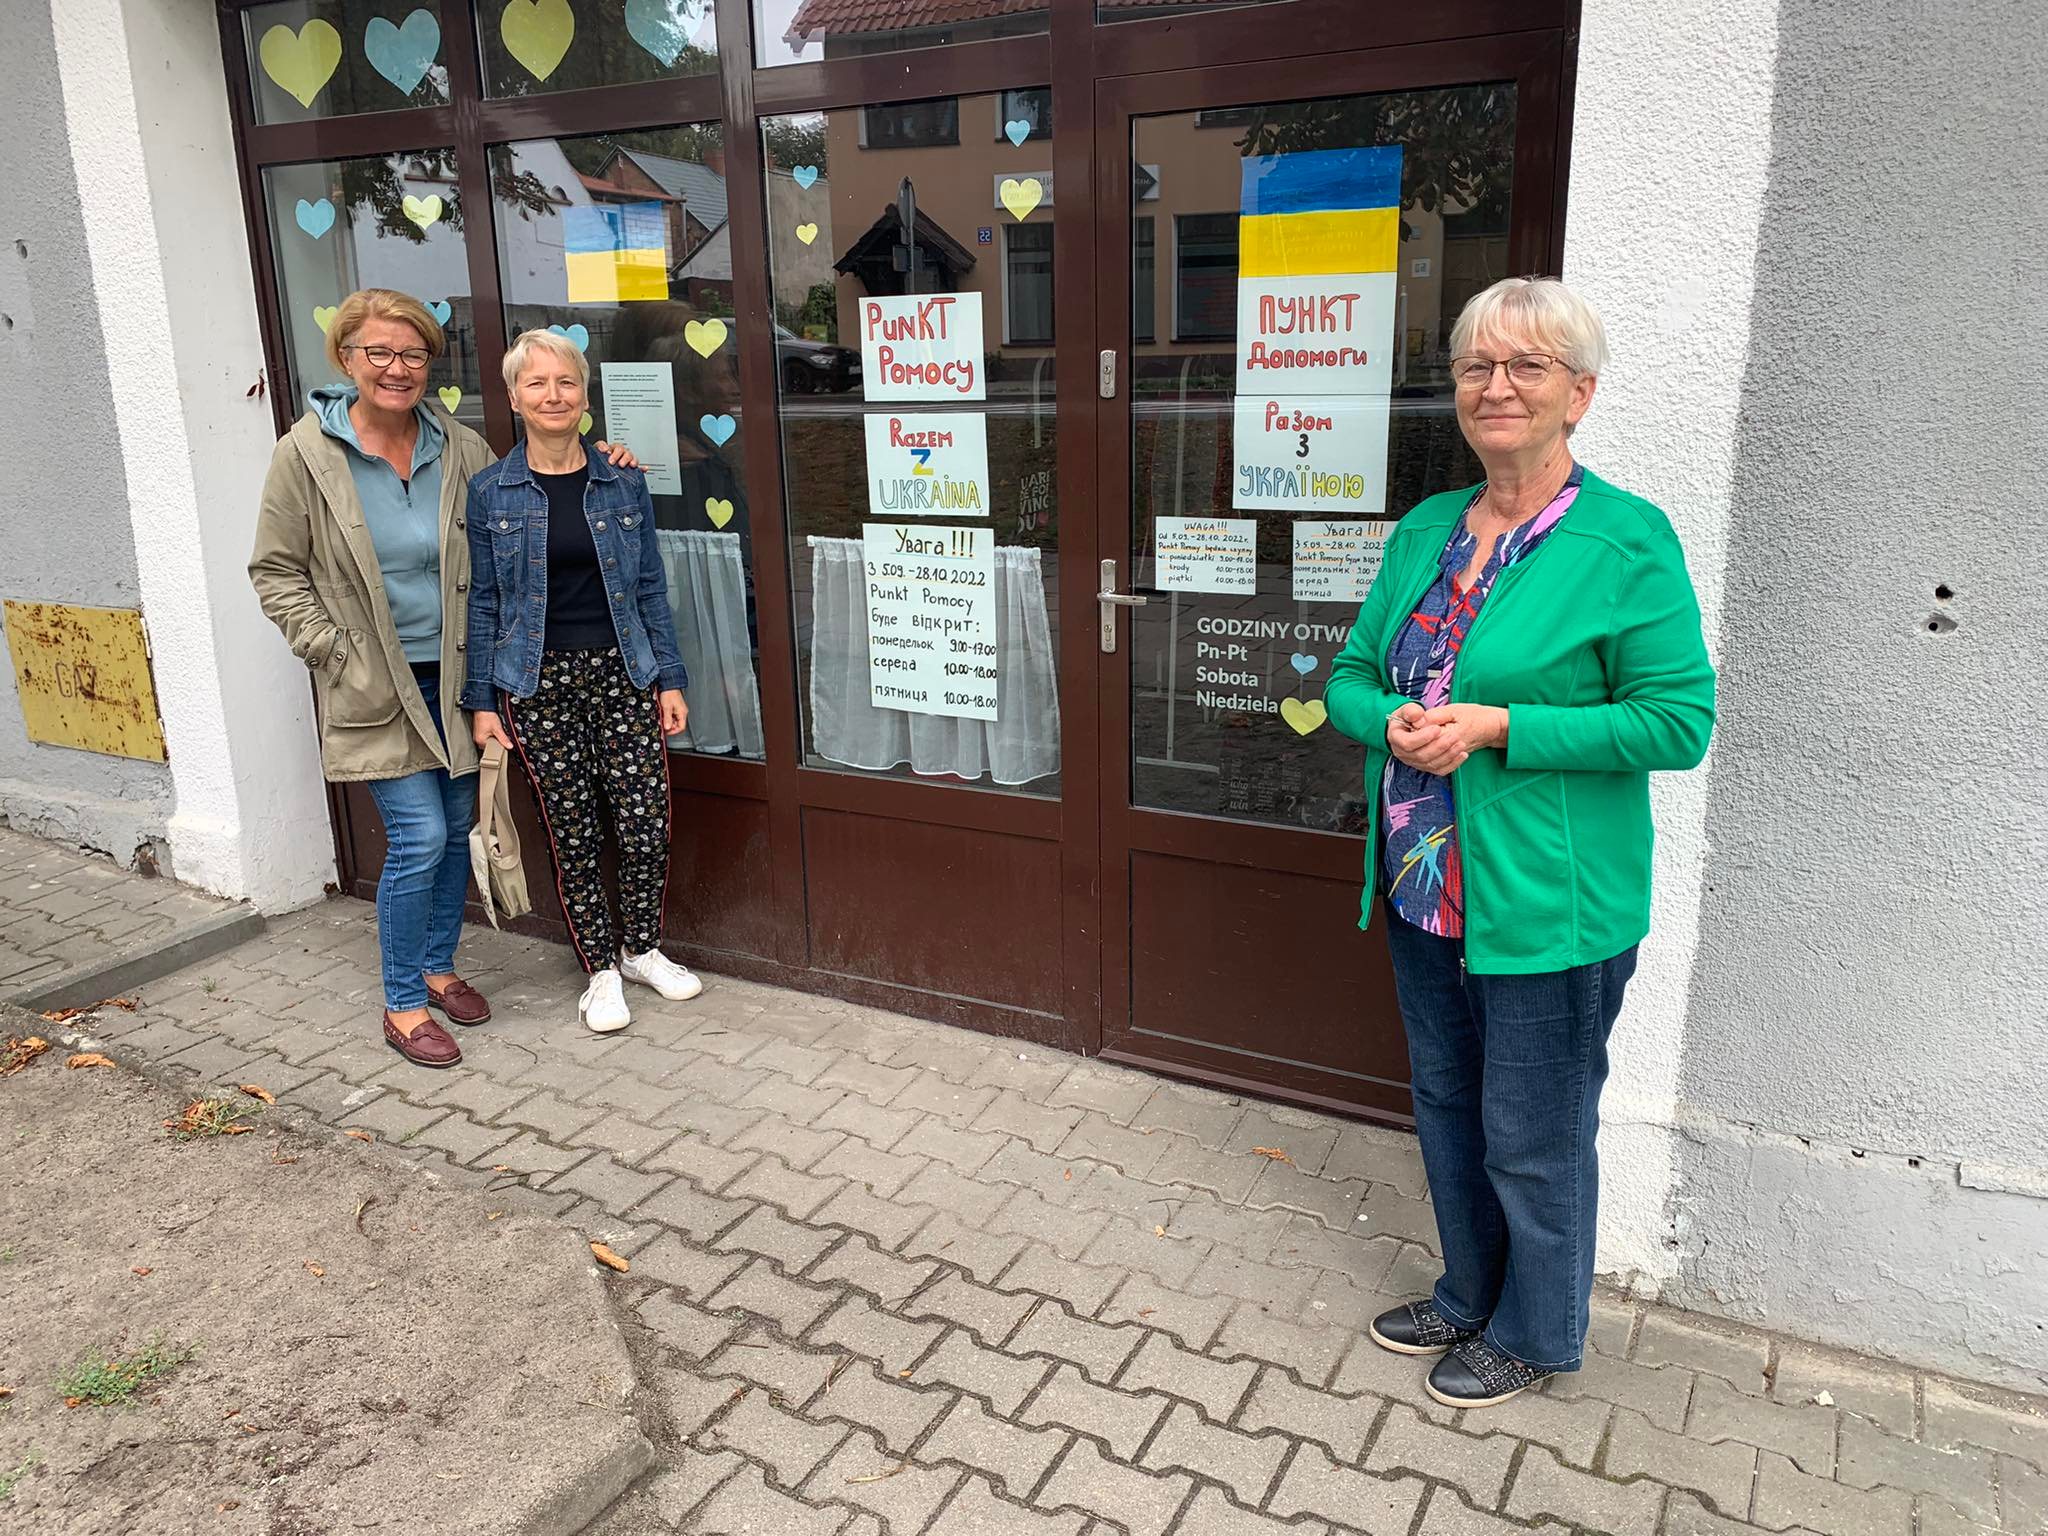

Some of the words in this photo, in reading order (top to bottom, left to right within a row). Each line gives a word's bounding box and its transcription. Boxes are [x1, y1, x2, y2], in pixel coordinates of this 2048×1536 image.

[1260, 294, 1361, 334] ПУНКТ
[1247, 342, 1368, 370] Допомоги
[1265, 401, 1332, 432] Разом
[1239, 464, 1365, 499] УКРАЇНОЮ
[1323, 523, 1363, 537] Увага
[894, 528, 945, 556] Увага
[1295, 552, 1316, 561] Punkt
[1294, 577, 1329, 587] середа
[870, 583, 909, 601] Punkt
[922, 587, 974, 616] Pomocy
[871, 607, 898, 628] буде
[1197, 617, 1291, 639] GODZINY
[1197, 641, 1248, 661] Pn-Pt
[873, 657, 917, 673] середа
[1196, 666, 1259, 687] Sobota
[1196, 690, 1279, 713] Niedziela
